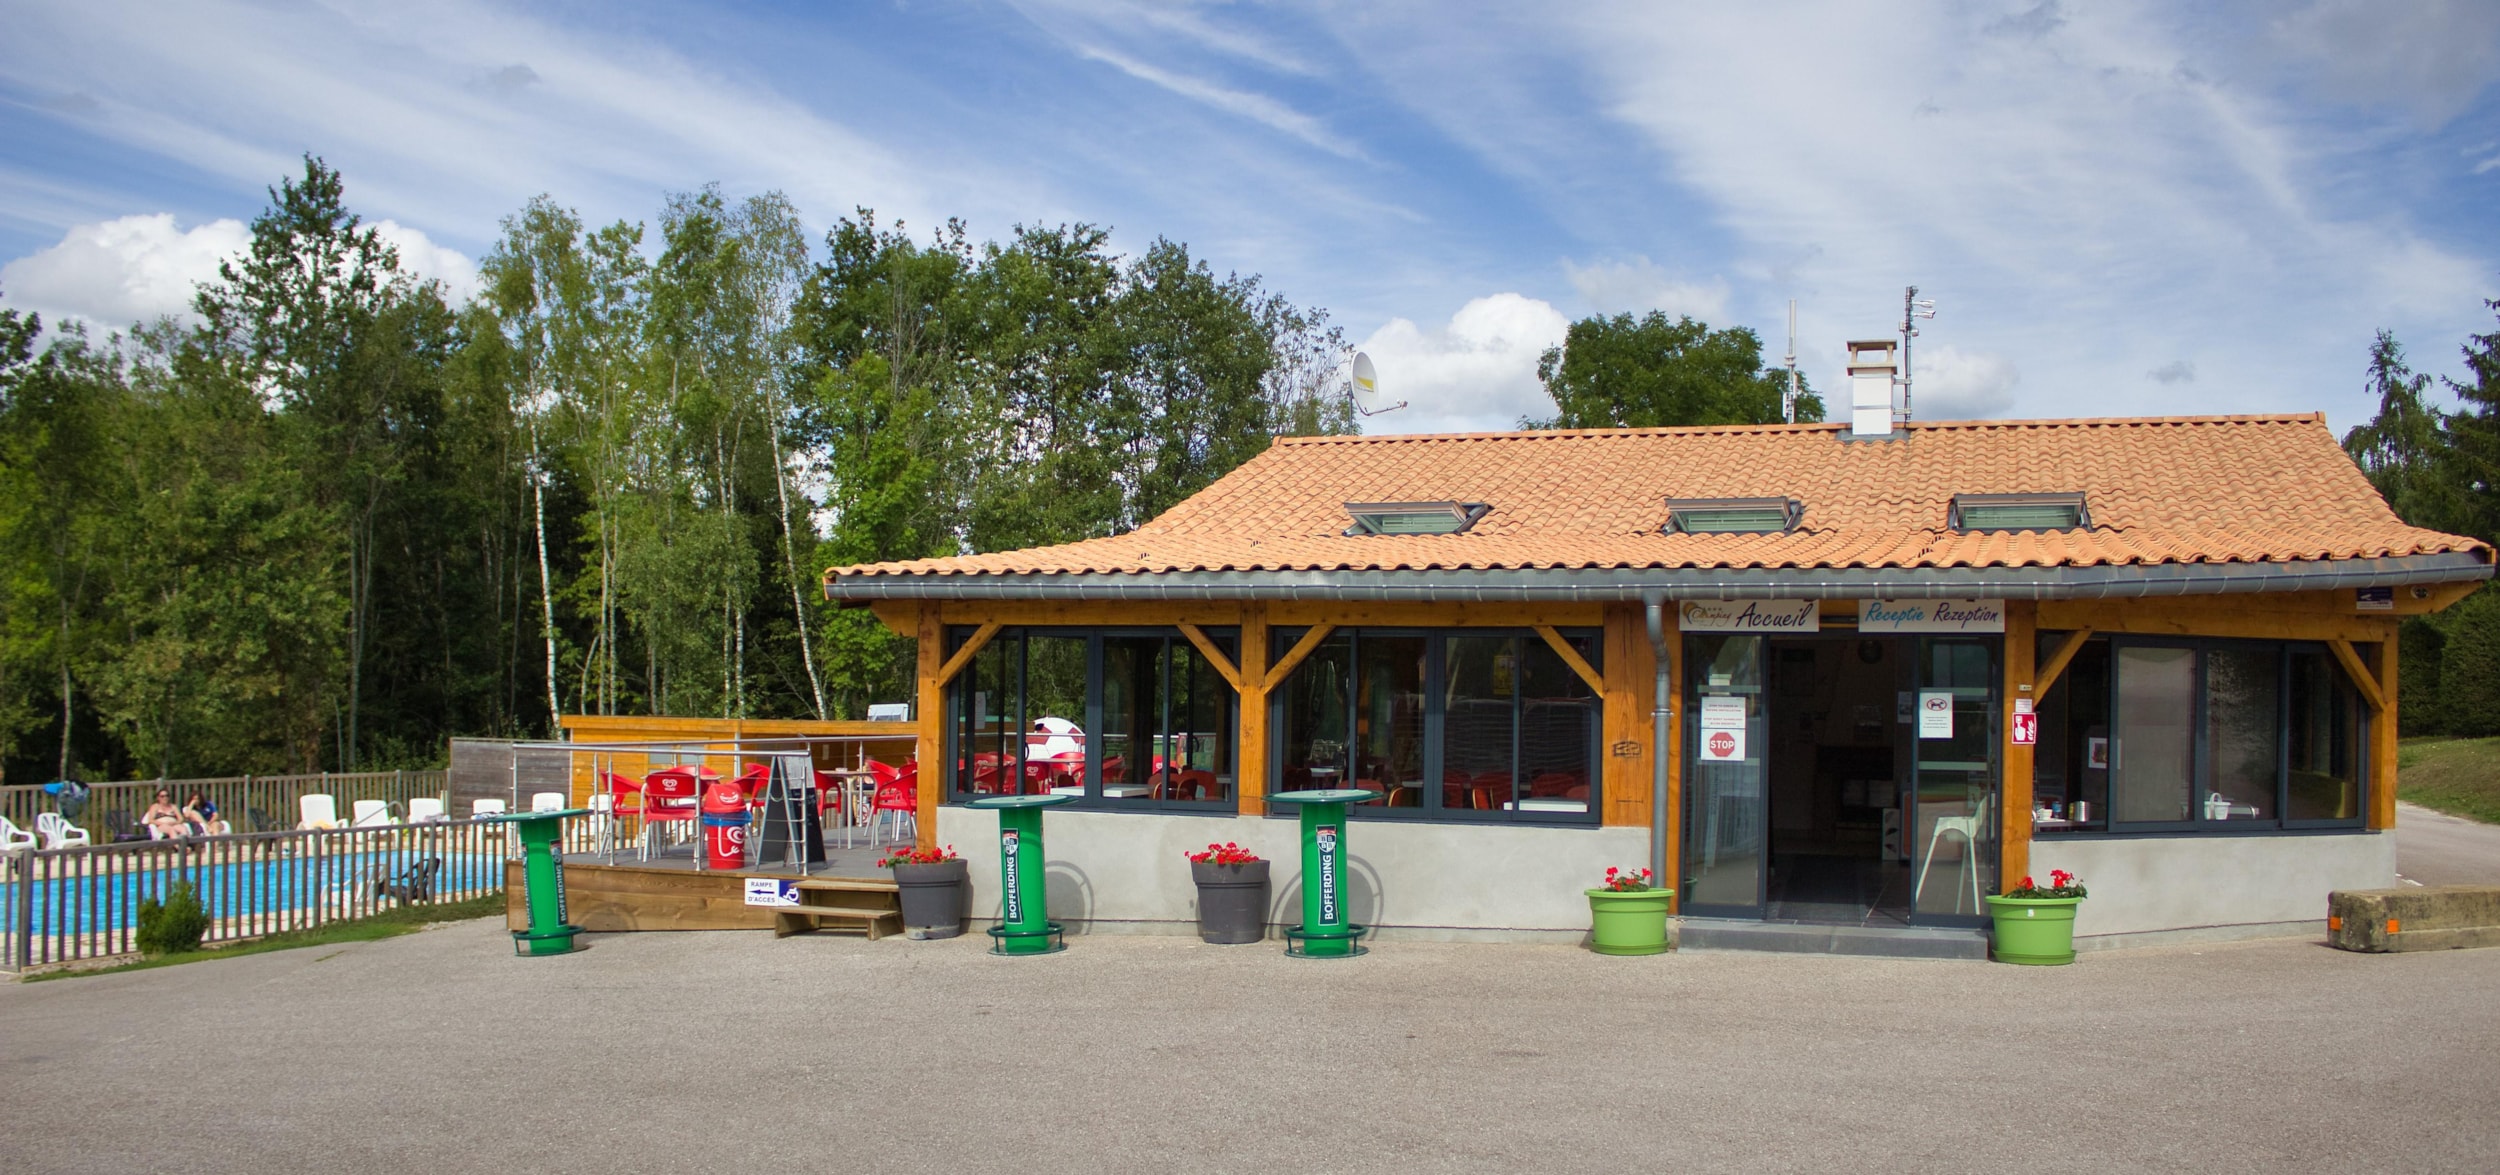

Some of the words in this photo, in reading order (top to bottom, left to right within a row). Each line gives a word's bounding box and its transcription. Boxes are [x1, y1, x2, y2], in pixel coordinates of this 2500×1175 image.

[1735, 602, 1813, 627] Accueil
[1865, 602, 1925, 628] Receptie
[1933, 602, 1998, 628] Rezeption
[1710, 740, 1734, 749] STOP
[556, 865, 567, 921] BOFFERDING
[1007, 857, 1017, 918] BOFFERDING
[1323, 855, 1333, 920] BOFFERDING
